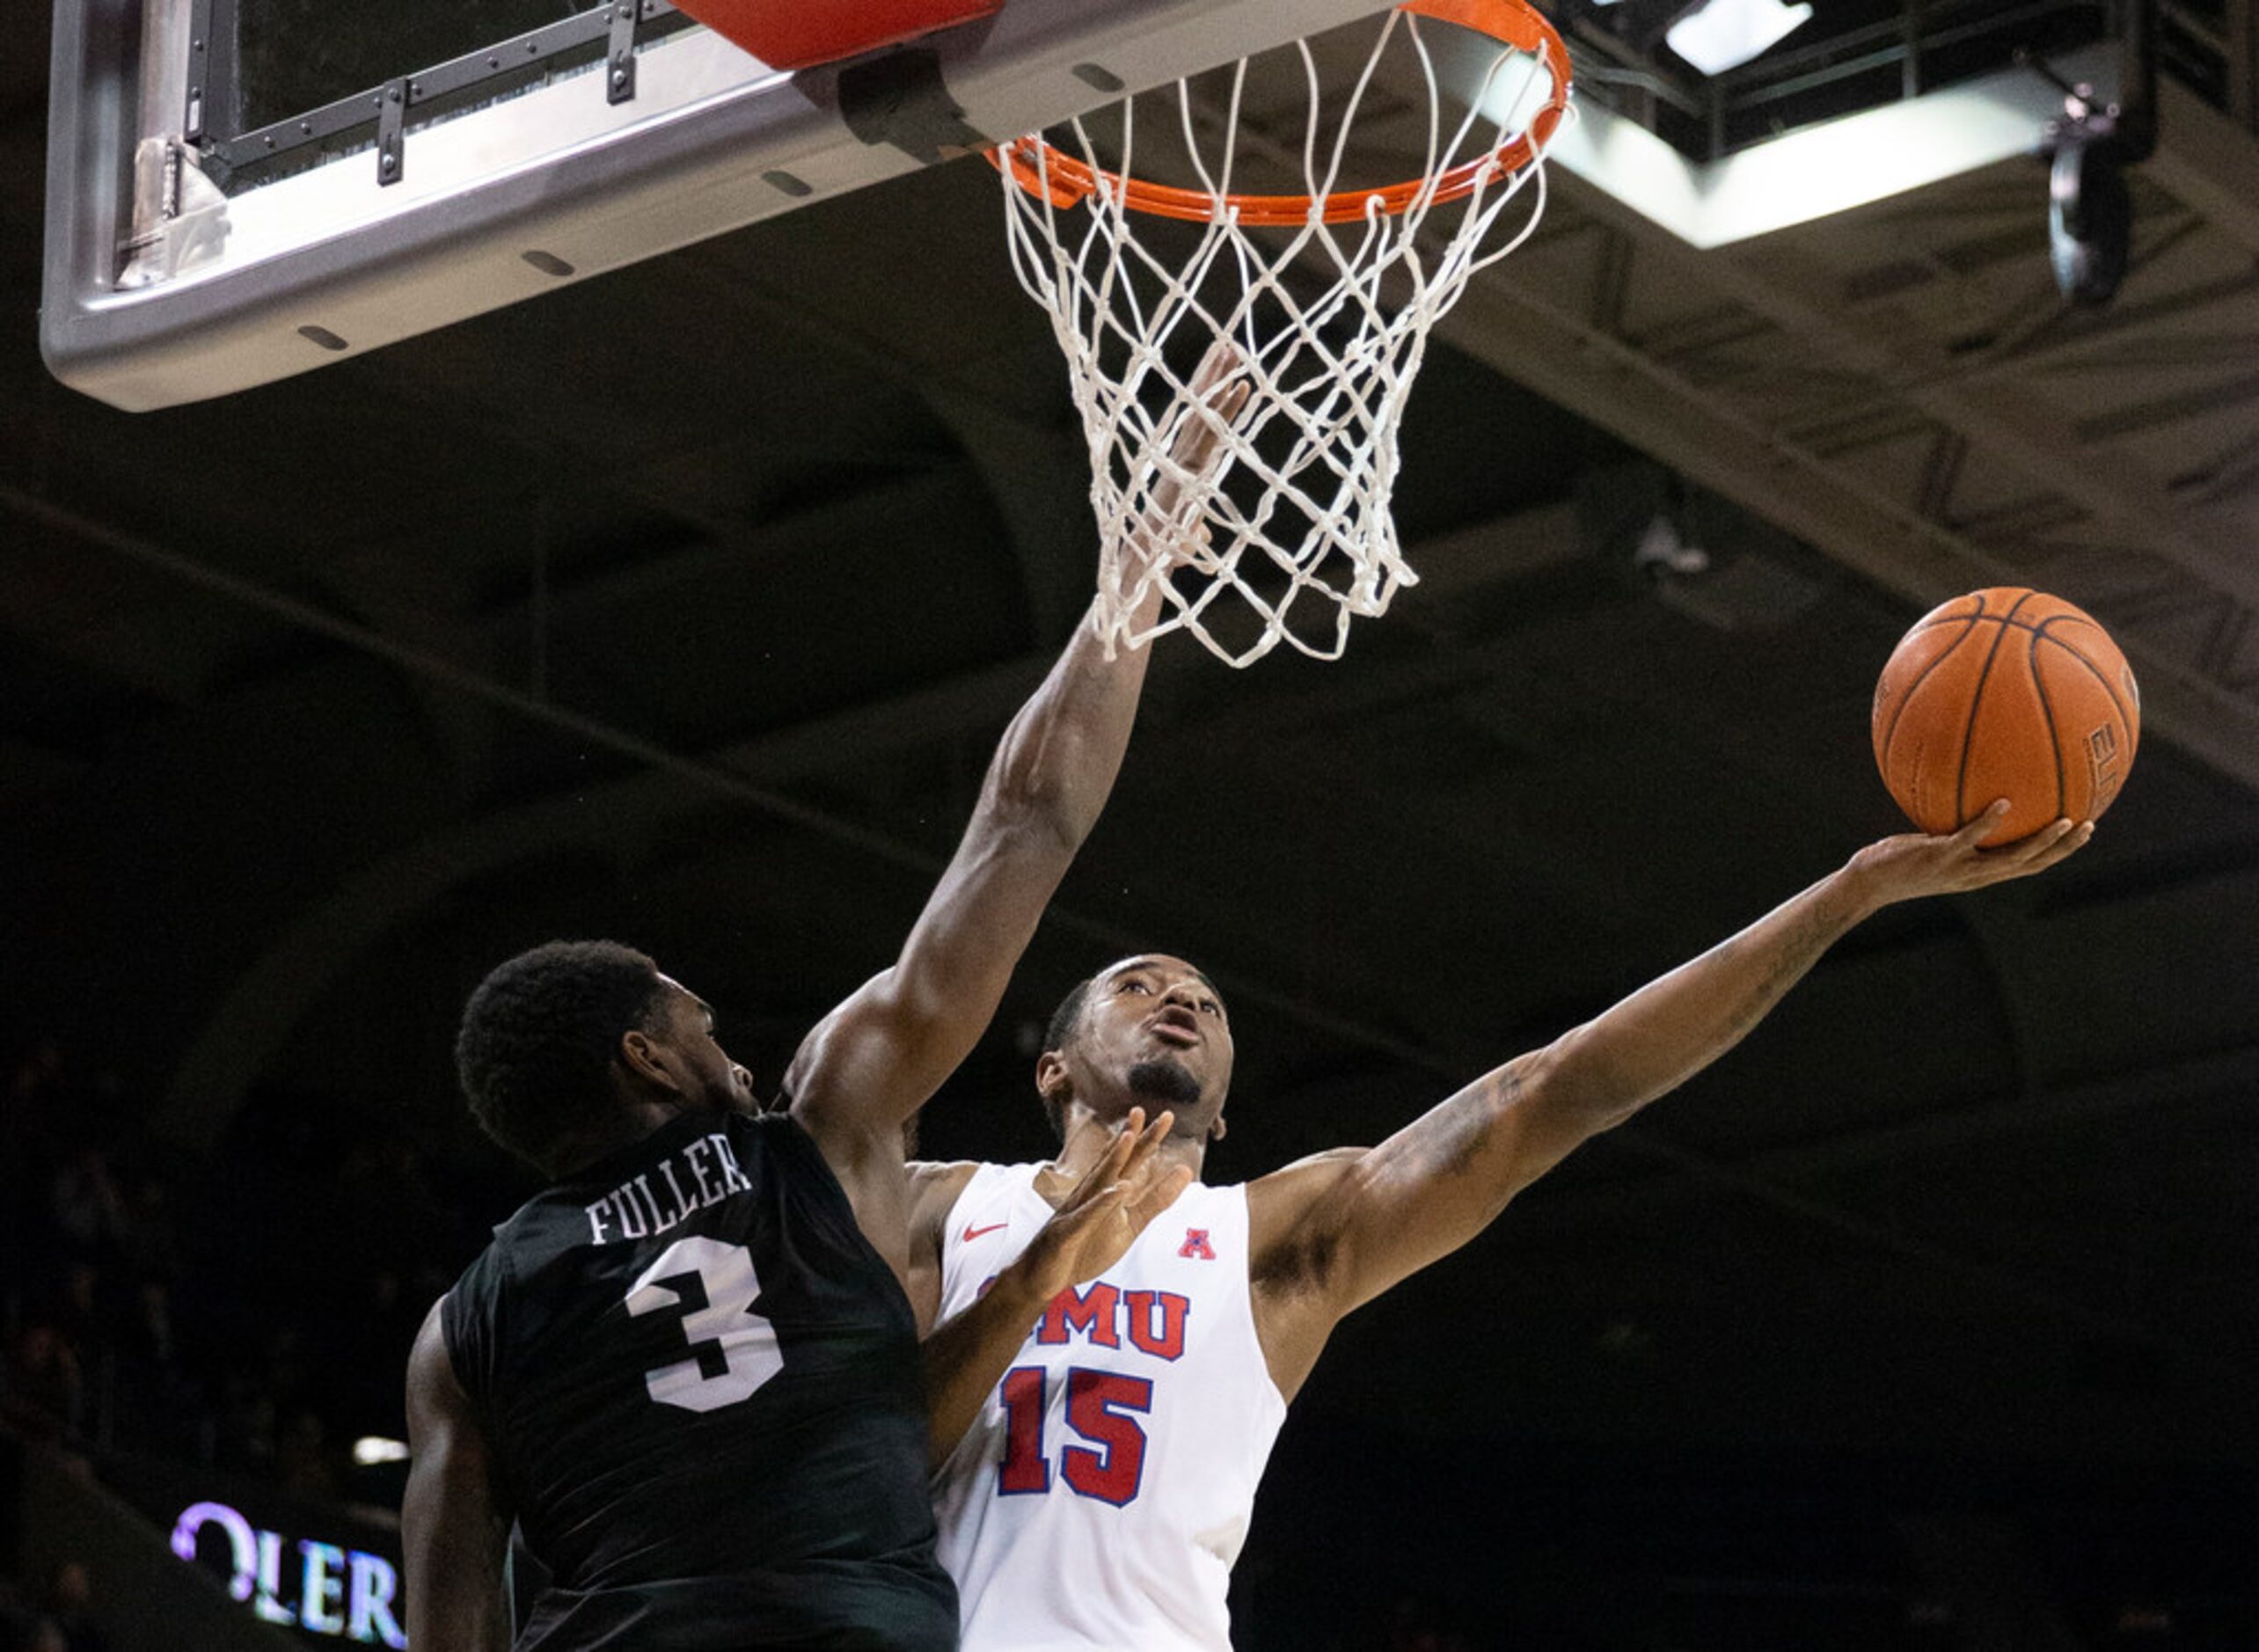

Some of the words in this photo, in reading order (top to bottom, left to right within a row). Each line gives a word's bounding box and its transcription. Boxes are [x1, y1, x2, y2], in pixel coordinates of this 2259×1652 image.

[585, 1134, 752, 1246] FULLER
[1178, 1228, 1216, 1260] A
[625, 1235, 785, 1413] 3
[977, 1276, 1190, 1362] MU
[998, 1365, 1153, 1509] 15
